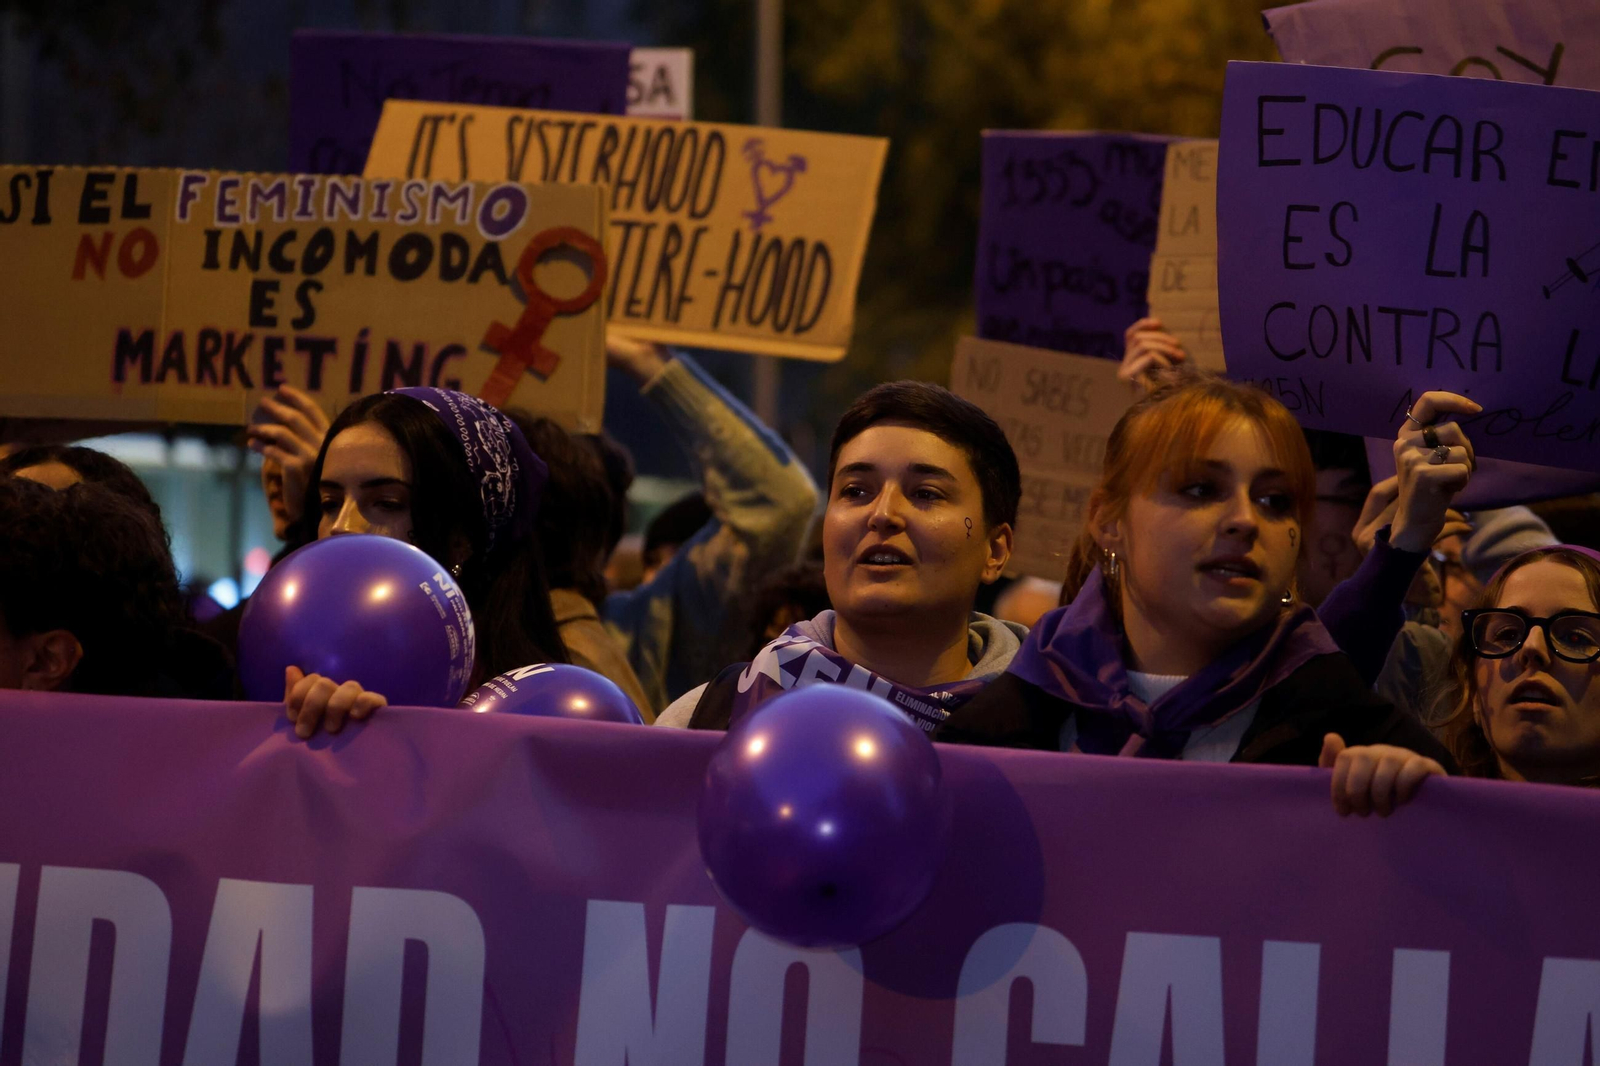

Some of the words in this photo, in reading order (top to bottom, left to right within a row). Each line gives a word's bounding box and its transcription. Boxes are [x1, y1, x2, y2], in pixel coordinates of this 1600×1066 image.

[406, 115, 473, 180] IT'S
[506, 115, 716, 219] SISTERHOOD
[1257, 95, 1506, 182] EDUCAR
[1546, 129, 1600, 192] E
[0, 171, 52, 224] SI
[78, 173, 151, 223] EL
[175, 175, 528, 240] FEMINISMO
[1283, 201, 1358, 270] ES
[1425, 203, 1490, 278] LA
[72, 228, 159, 281] NO
[203, 228, 512, 286] INCOMODA
[249, 280, 323, 331] ES
[1264, 302, 1502, 372] CONTRA
[573, 898, 864, 1066] NO
